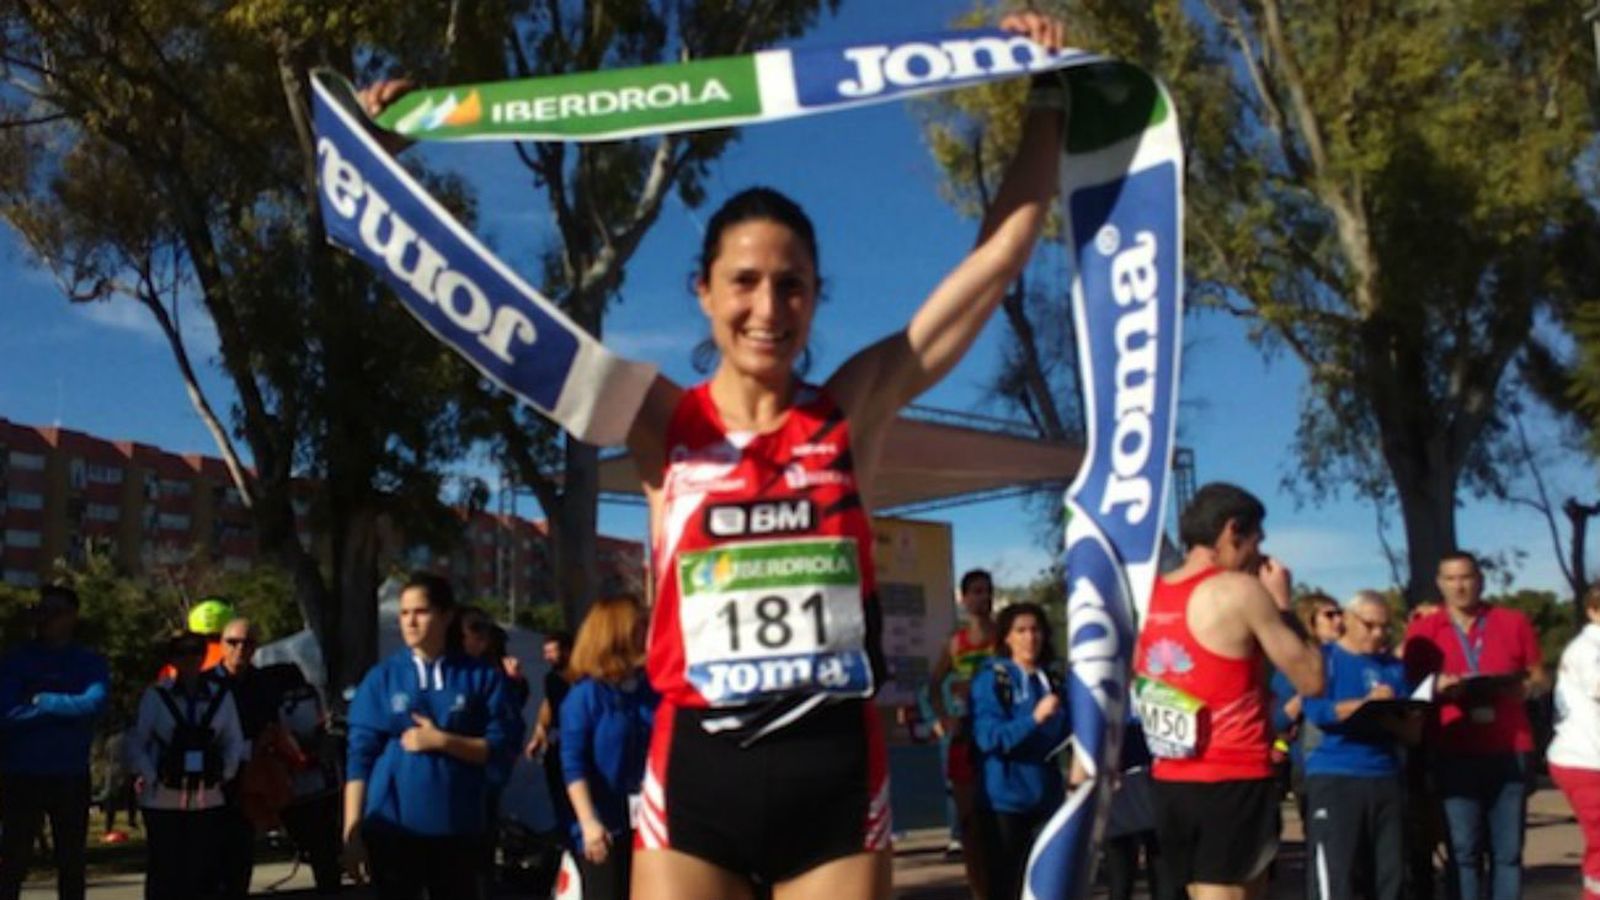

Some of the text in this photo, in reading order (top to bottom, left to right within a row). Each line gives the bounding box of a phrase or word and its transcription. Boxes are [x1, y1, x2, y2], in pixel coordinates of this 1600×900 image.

[491, 78, 731, 124] IBERDROLA
[751, 500, 811, 533] BM
[733, 556, 850, 579] IBERDROLA
[717, 591, 828, 651] 181
[1140, 704, 1188, 741] M50
